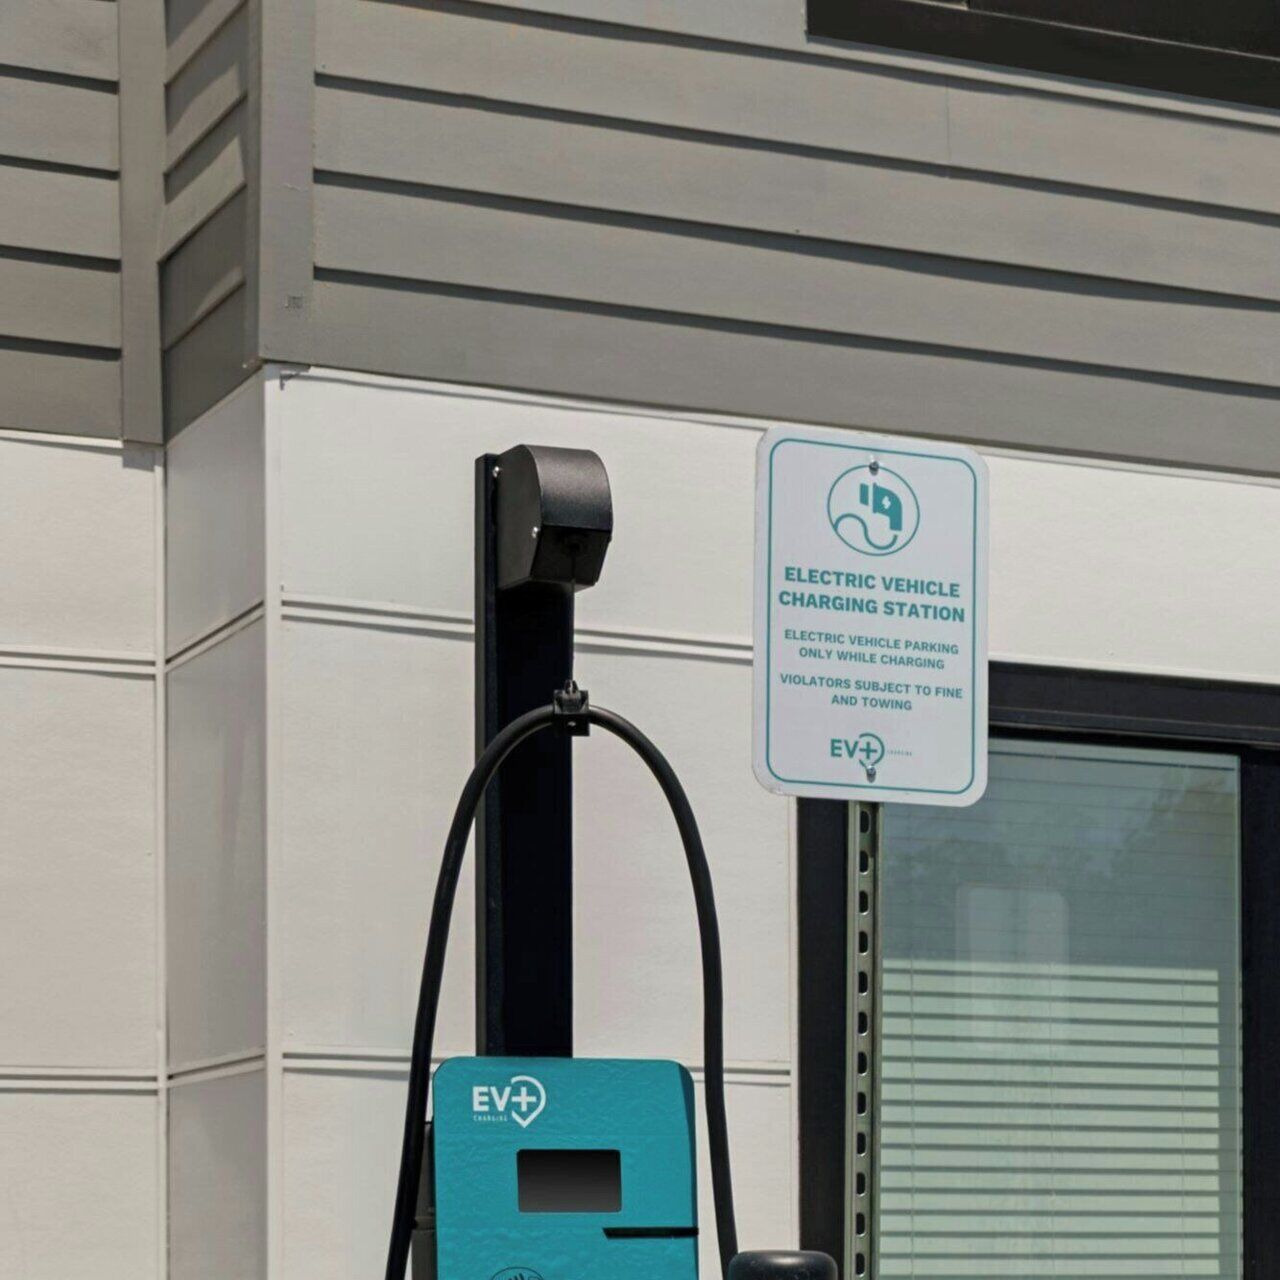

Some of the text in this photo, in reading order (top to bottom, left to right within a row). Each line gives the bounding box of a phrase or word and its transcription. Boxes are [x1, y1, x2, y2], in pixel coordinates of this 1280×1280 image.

[784, 566, 960, 598] ELECTRIC VEHICLE
[778, 591, 965, 623] CHARGING STATION
[784, 629, 959, 655] ELECTRIC VEHICLE PARKING
[799, 647, 945, 670] ONLY WHILE CHARGING
[780, 673, 963, 699] VIOLATORS SUBJECT TO FINE
[831, 694, 913, 711] AND TOWING
